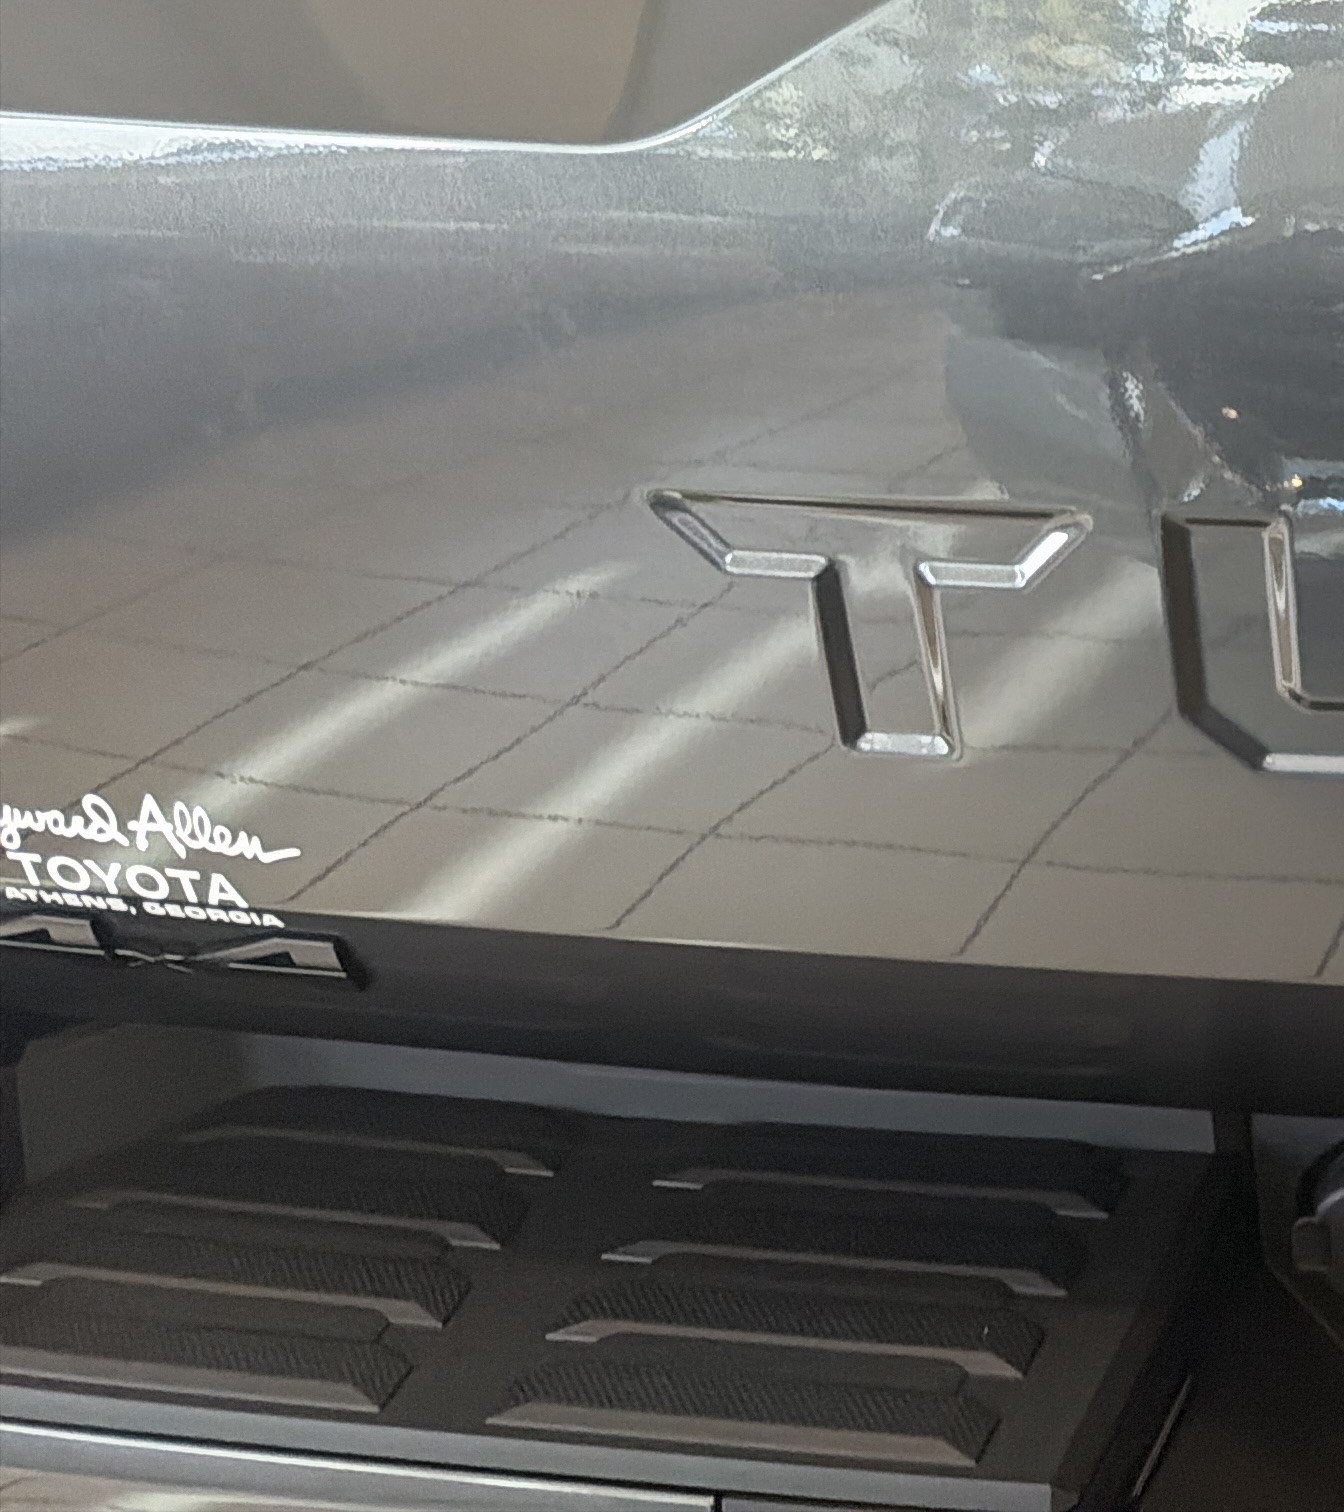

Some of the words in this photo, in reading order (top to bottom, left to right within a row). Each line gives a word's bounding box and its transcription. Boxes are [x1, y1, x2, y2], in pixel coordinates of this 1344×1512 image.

[0, 793, 130, 850] yward
[128, 793, 301, 863] Allen
[5, 886, 137, 916] ATHENS,
[142, 901, 286, 929] GEORGIA
[6, 851, 249, 908] TOYOTA
